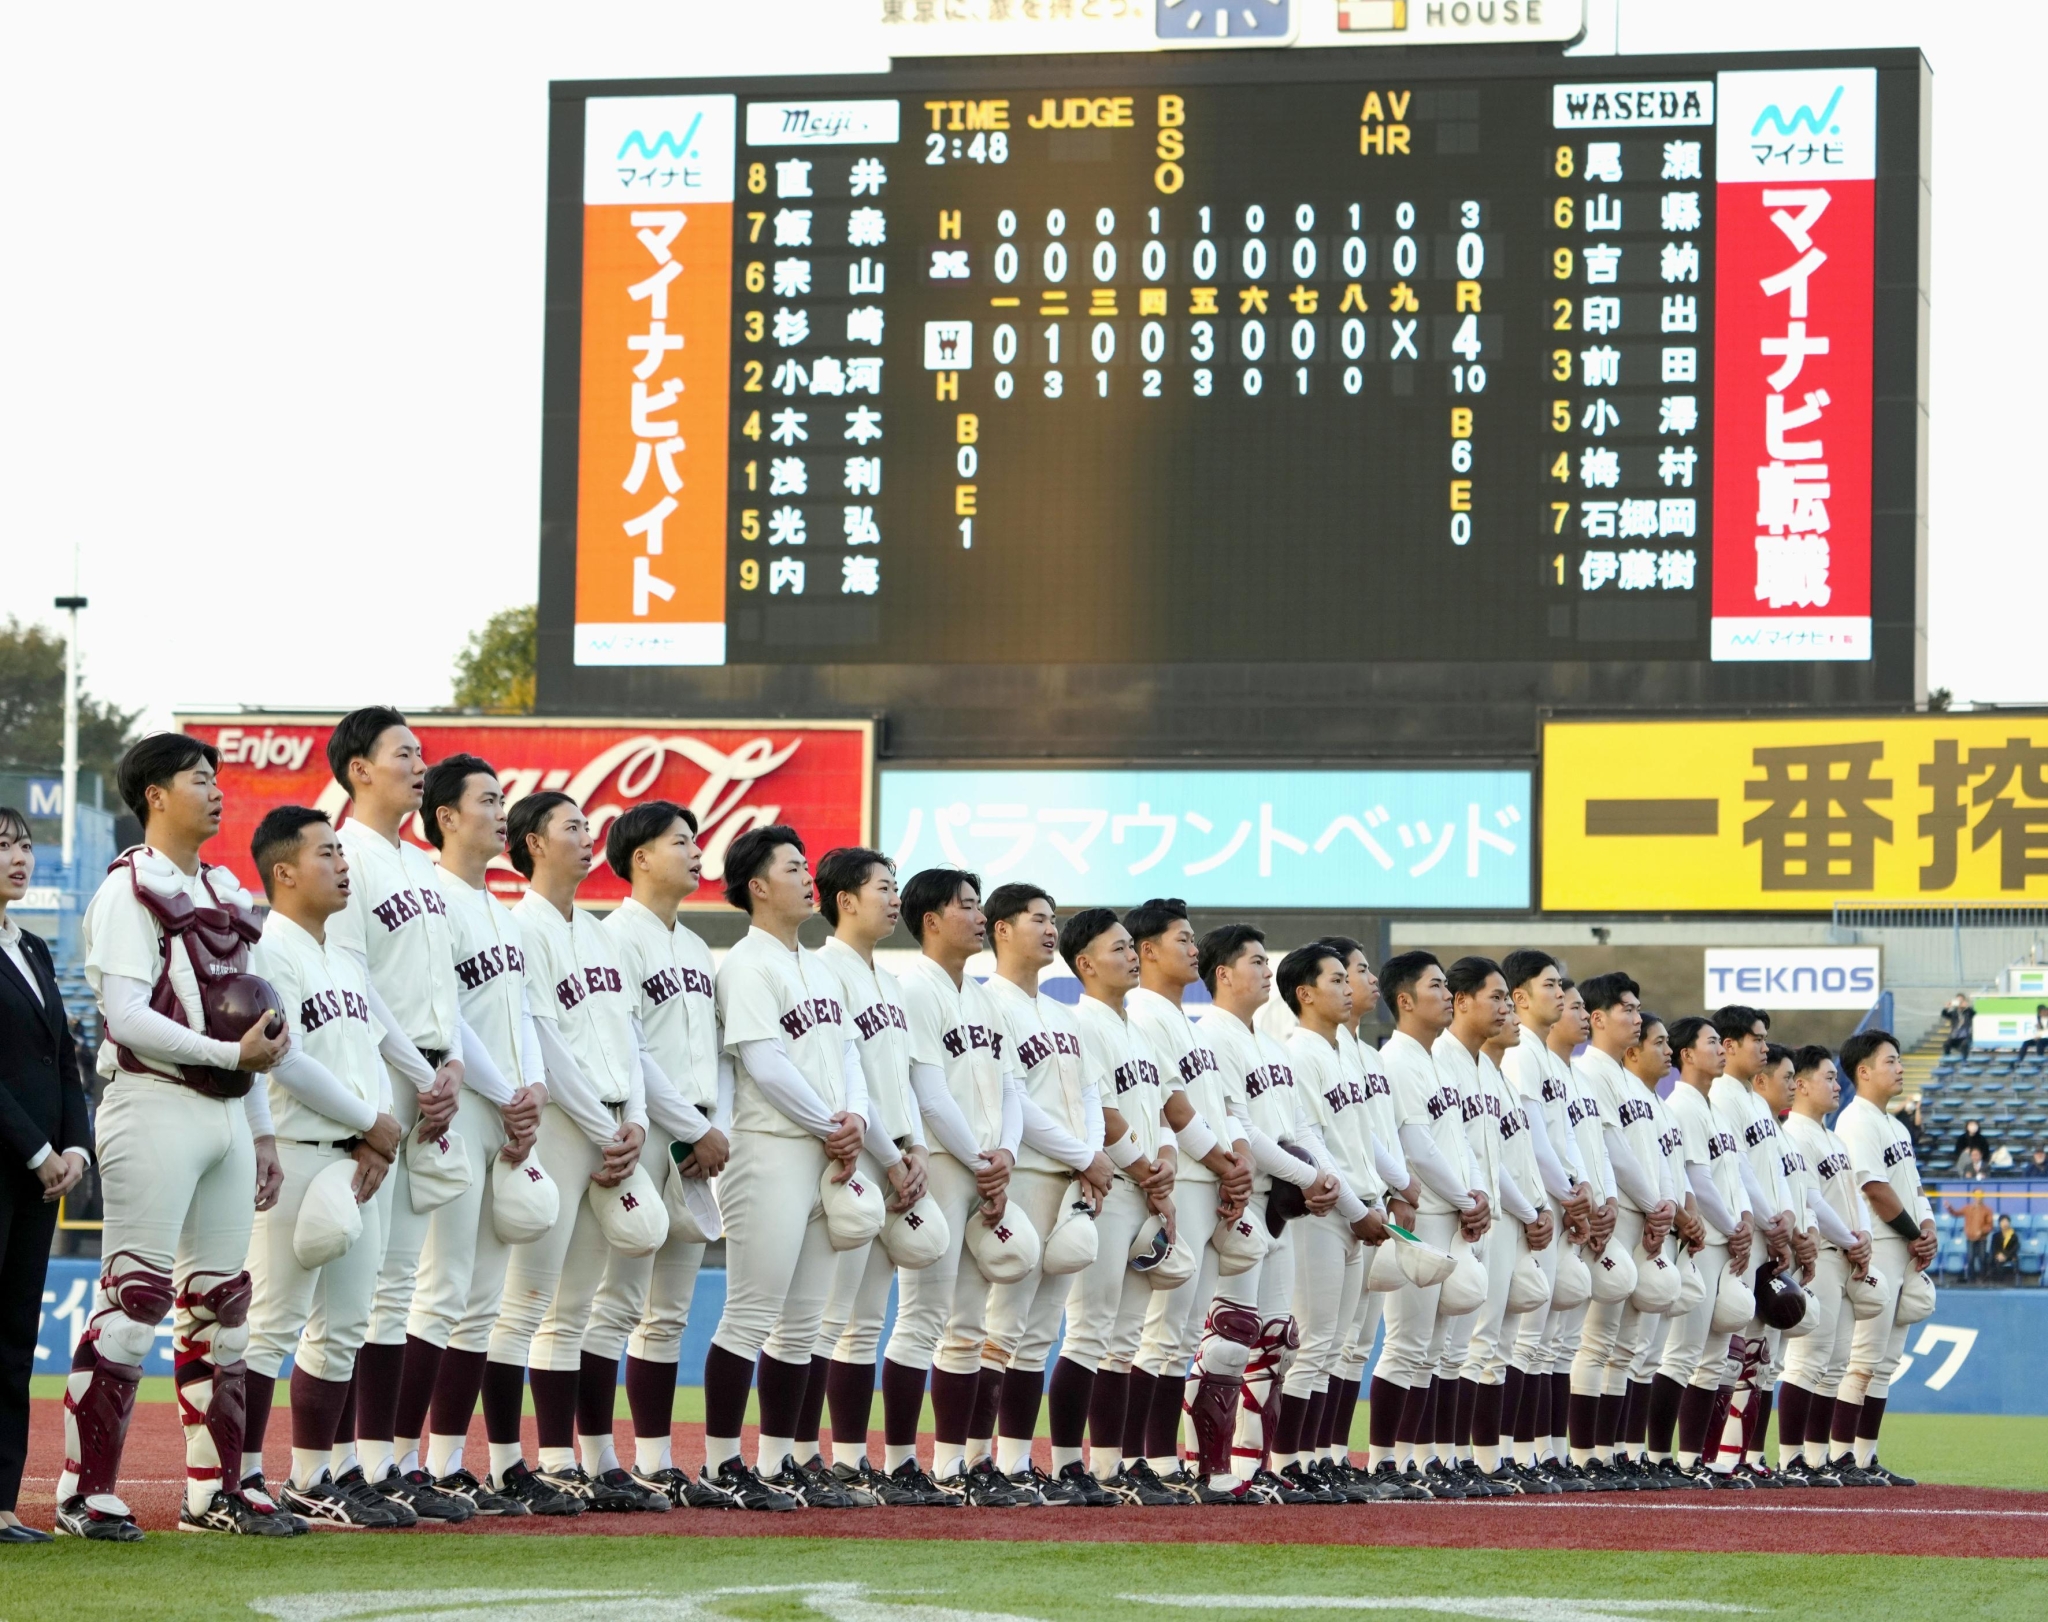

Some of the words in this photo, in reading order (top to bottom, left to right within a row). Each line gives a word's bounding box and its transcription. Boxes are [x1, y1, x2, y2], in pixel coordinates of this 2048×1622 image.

[1427, 0, 1541, 25] HOUSE
[925, 100, 1010, 130] TIME
[1028, 97, 1134, 129] JUDGE
[1361, 91, 1410, 121] AV
[1566, 90, 1702, 121] WASEDA
[926, 132, 1008, 165] 2:48
[1361, 125, 1410, 154] HR
[1750, 142, 1845, 166] マイナビ
[1555, 146, 1573, 177] 8
[618, 167, 702, 189] マイナビ
[748, 163, 766, 193] 8
[748, 212, 765, 242] 7
[940, 210, 961, 239] H
[998, 210, 1016, 237] 0
[1047, 209, 1065, 236] 0
[1096, 208, 1114, 235] 0
[1148, 207, 1159, 234] 1
[1199, 206, 1210, 233] 1
[1246, 205, 1264, 232] 0
[1296, 204, 1314, 231] 0
[1349, 203, 1359, 230] 1
[1396, 202, 1414, 229] 0
[1461, 201, 1479, 228] 3
[1555, 197, 1573, 228] 6
[995, 243, 1018, 283] 0
[1044, 242, 1067, 282] 0
[1093, 241, 1116, 282] 0
[1142, 240, 1166, 281] 0
[1193, 240, 1216, 280] 0
[1243, 239, 1266, 279] 0
[1293, 238, 1316, 278] 0
[1343, 237, 1366, 277] 0
[1393, 236, 1416, 276] 0
[1457, 232, 1484, 279] 0
[1554, 248, 1572, 279] 9
[746, 262, 764, 292] 6
[991, 298, 1020, 306] 一
[1040, 291, 1069, 315] 二
[1089, 289, 1118, 315] 三
[1139, 288, 1167, 316] 四
[1189, 288, 1218, 314] 五
[1239, 286, 1268, 314] 六
[1289, 285, 1318, 313] 七
[1340, 284, 1367, 312] 八
[1390, 282, 1418, 311] 九
[1457, 281, 1481, 312] R
[745, 311, 763, 341] 3
[1554, 299, 1572, 330] 2
[993, 324, 1016, 364] 0
[1044, 323, 1059, 363] 1
[1092, 322, 1115, 363] 0
[1141, 322, 1164, 362] 0
[1191, 321, 1214, 361] 3
[1242, 320, 1265, 360] 0
[1292, 319, 1315, 360] 0
[1342, 319, 1365, 359] 0
[1391, 319, 1417, 359] X
[1452, 314, 1481, 361] 4
[744, 361, 762, 391] 2
[772, 356, 883, 396] 小島河
[1553, 350, 1571, 380] 3
[937, 371, 958, 401] H
[995, 371, 1013, 398] 0
[1044, 371, 1062, 398] 3
[1096, 370, 1107, 397] 1
[1143, 369, 1161, 396] 2
[1194, 369, 1212, 396] 3
[1243, 368, 1262, 395] 0
[1297, 367, 1307, 394] 1
[1344, 367, 1362, 394] 0
[1452, 365, 1486, 392] 10
[1754, 188, 1836, 609] マイナビ転職
[622, 211, 690, 617] マイナビバイト
[743, 411, 761, 440] 4
[957, 414, 978, 443] B
[1452, 408, 1472, 437] B
[1553, 401, 1570, 431] 5
[957, 446, 977, 477] 0
[1452, 440, 1471, 472] 6
[1552, 452, 1570, 482] 4
[745, 461, 756, 490] 1
[956, 485, 977, 515] E
[1451, 481, 1471, 510] E
[741, 510, 759, 540] 5
[959, 518, 971, 548] 1
[1451, 513, 1470, 545] 0
[1552, 503, 1569, 533] 7
[1581, 498, 1696, 538] 石郷岡
[740, 559, 759, 590] 9
[1554, 555, 1564, 585] 1
[1579, 549, 1696, 590] 伊藤樹
[216, 729, 314, 771] Enjoy
[895, 803, 1521, 878] パラマウントベッド
[1708, 967, 1875, 993] TEKNOS
